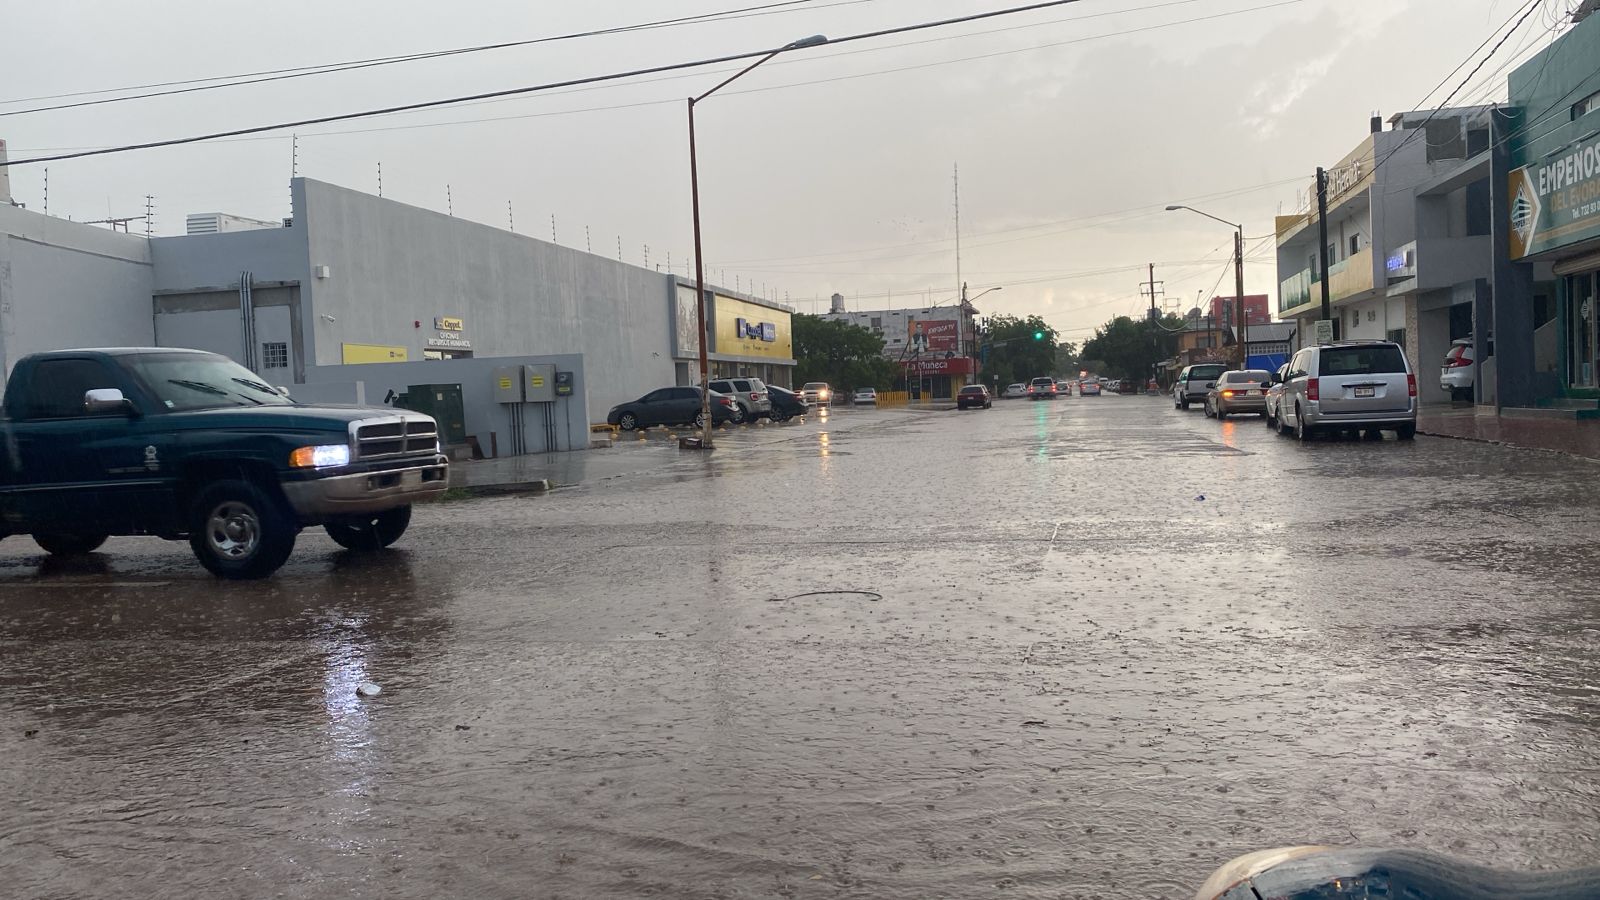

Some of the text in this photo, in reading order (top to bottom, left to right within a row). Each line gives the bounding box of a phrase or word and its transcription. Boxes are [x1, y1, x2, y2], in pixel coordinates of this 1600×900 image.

[1539, 143, 1600, 196] EMPEÑOS
[1551, 193, 1568, 211] DEL
[444, 320, 461, 331] Coppel
